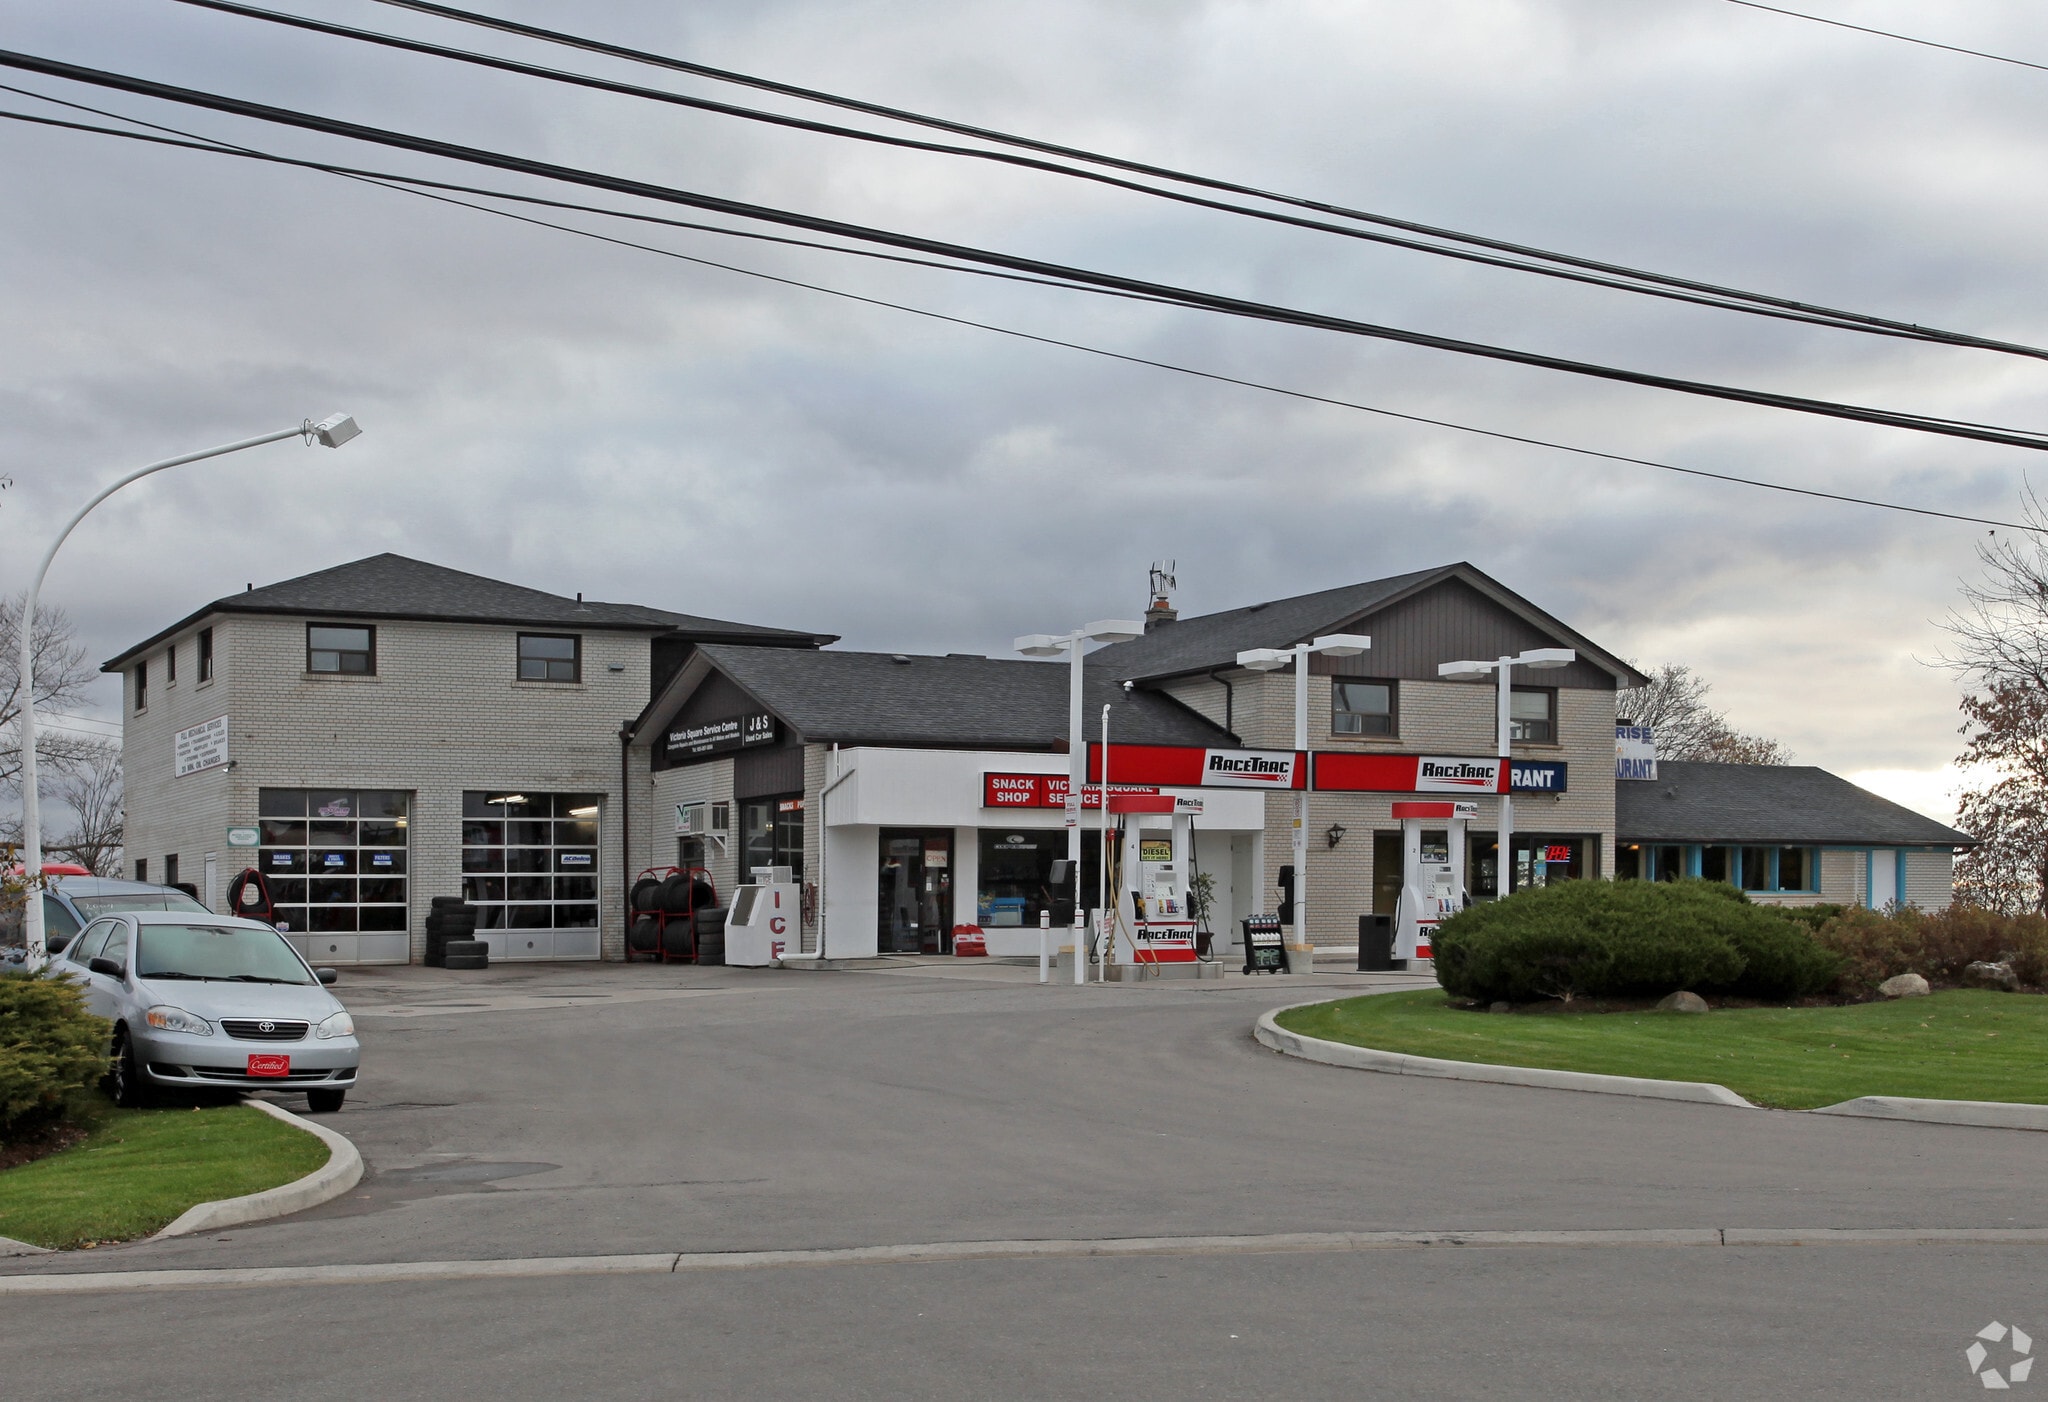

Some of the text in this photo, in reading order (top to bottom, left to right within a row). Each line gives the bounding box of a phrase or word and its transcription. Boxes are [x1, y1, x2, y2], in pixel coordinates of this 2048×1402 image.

[750, 715, 768, 731] J & S
[670, 721, 738, 741] Victoria Square Service Centre
[745, 734, 755, 742] Used
[762, 732, 772, 740] Sales
[992, 779, 1034, 789] SNACK
[996, 792, 1030, 802] SHOP
[1546, 846, 1568, 860] OPEN
[770, 892, 786, 960] ICE
[252, 1060, 284, 1069] Certified
